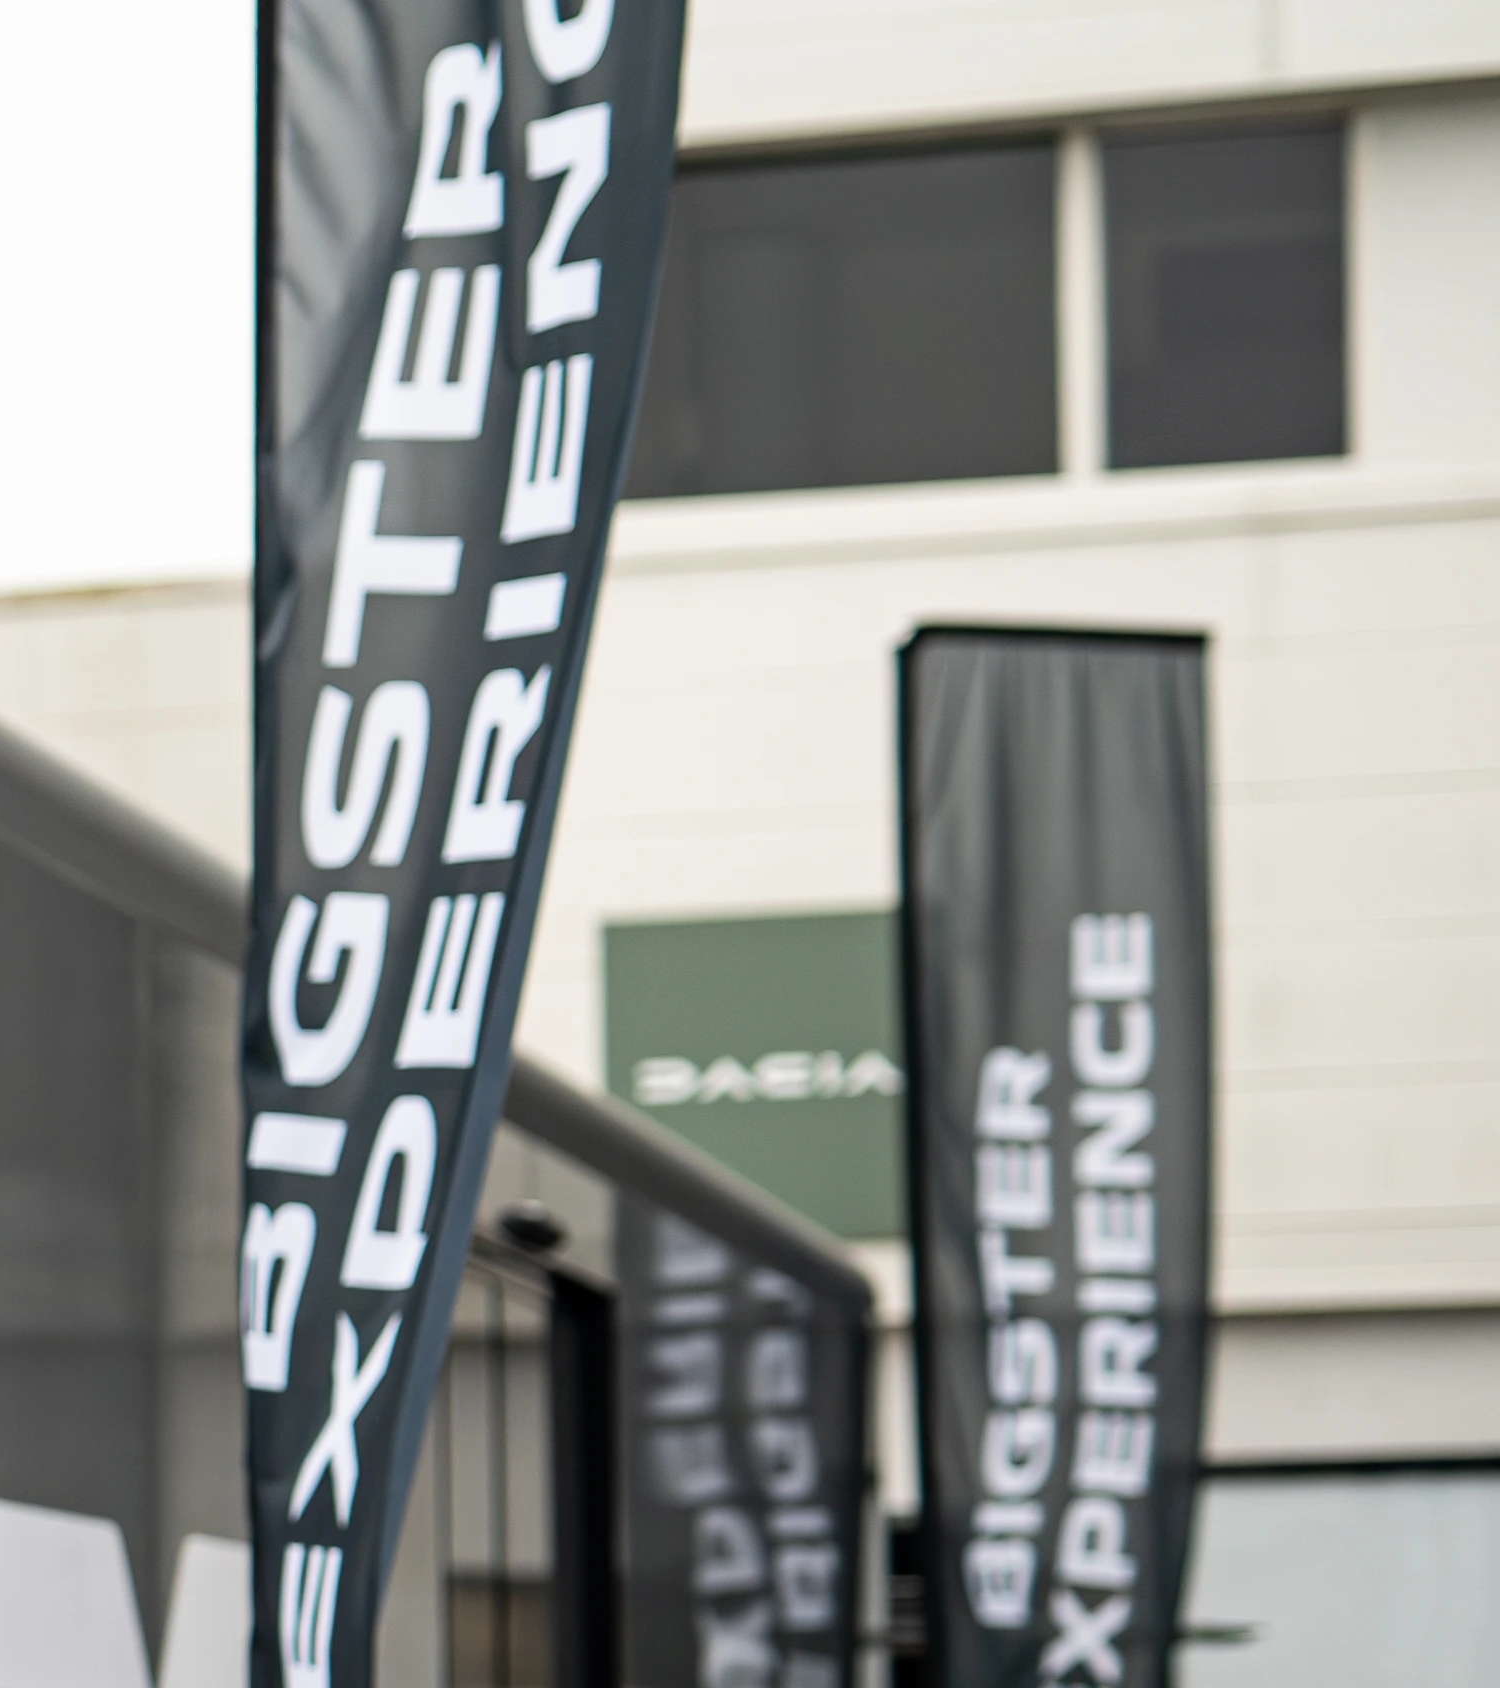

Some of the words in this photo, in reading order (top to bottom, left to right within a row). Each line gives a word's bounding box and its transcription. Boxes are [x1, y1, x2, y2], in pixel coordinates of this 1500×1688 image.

[243, 42, 502, 1390] BIGSTER
[633, 1050, 903, 1105] DACIA
[967, 1046, 1056, 1626] BIGSTER
